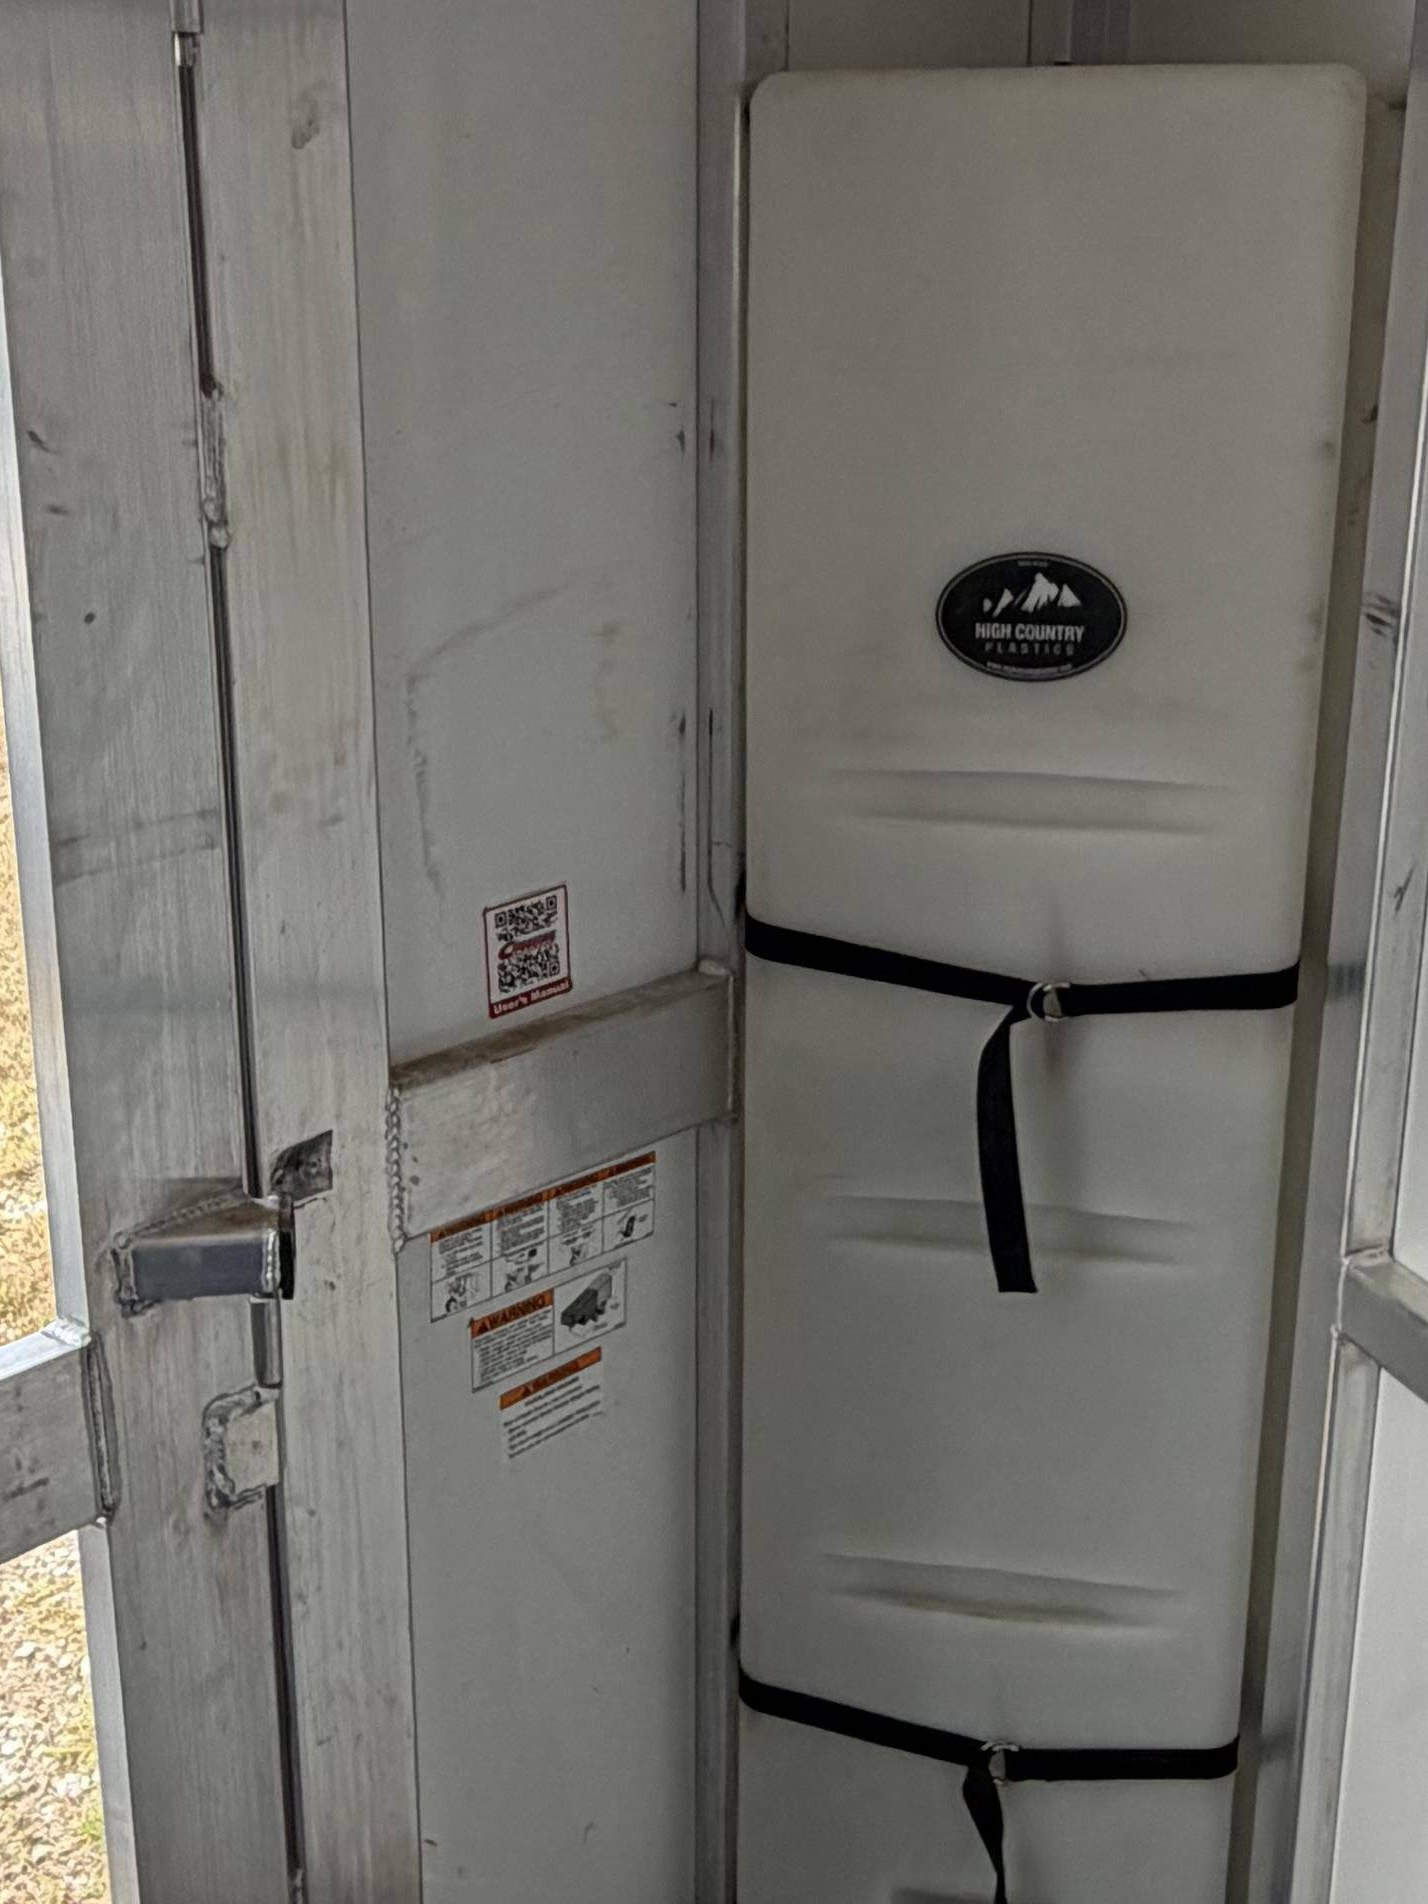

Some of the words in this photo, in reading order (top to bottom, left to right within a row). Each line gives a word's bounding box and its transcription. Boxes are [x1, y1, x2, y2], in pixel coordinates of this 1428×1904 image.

[974, 622, 1012, 639] HIGH
[1015, 623, 1084, 642] COUNTRY
[985, 642, 1074, 656] PLASTICS
[493, 997, 528, 1014] User's
[489, 1294, 545, 1327] WARNING
